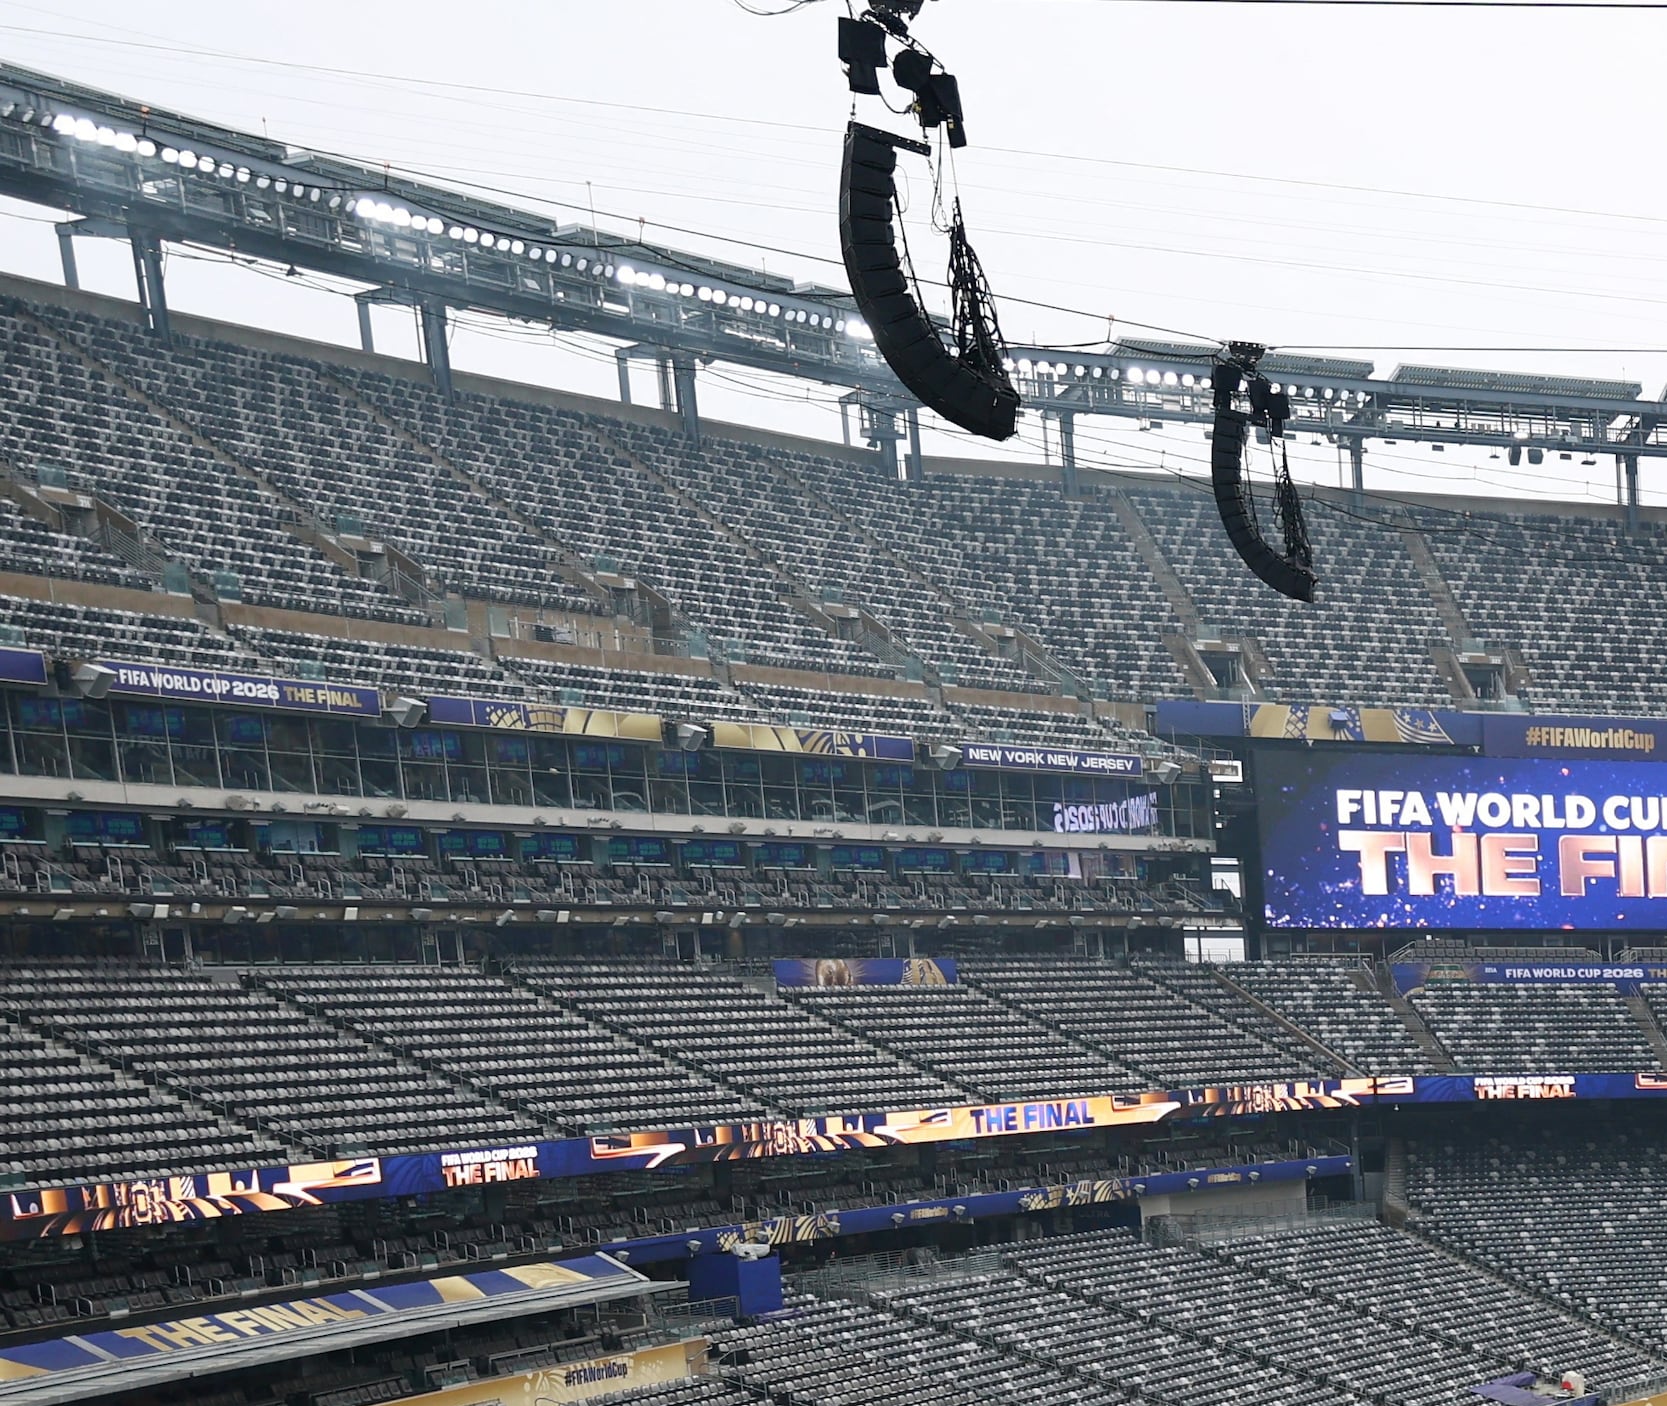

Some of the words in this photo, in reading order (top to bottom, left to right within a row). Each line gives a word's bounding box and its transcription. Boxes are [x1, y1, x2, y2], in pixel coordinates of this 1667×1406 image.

[119, 669, 149, 687] FIFA
[149, 673, 200, 692] WORLD
[202, 679, 230, 696] CUP
[232, 681, 280, 701] 2026
[284, 689, 314, 704] THE
[317, 692, 363, 707] FINAL
[1526, 726, 1655, 753] #FIFAWorldCup
[969, 748, 1002, 762] NEW
[1004, 752, 1045, 765] YORK
[1046, 755, 1077, 767] NEW
[1081, 758, 1133, 771] JERSEY
[1337, 790, 1432, 826] FIFA
[1440, 793, 1596, 829] WORLD
[1337, 830, 1541, 898] THE
[1505, 968, 1533, 978] FIFA
[1534, 968, 1577, 978] WORLD
[1578, 968, 1601, 978] CUP
[1603, 968, 1644, 978] 2026
[1474, 1085, 1516, 1099] THE
[1517, 1084, 1576, 1099] FINAL
[970, 1106, 1018, 1134] THE
[1023, 1101, 1095, 1129] FINAL
[442, 1163, 482, 1187] THE
[484, 1158, 540, 1183] FINAL
[117, 1316, 241, 1352] THE
[213, 1298, 368, 1337] FINAL
[564, 1361, 628, 1388] #FIFAWorldCup
